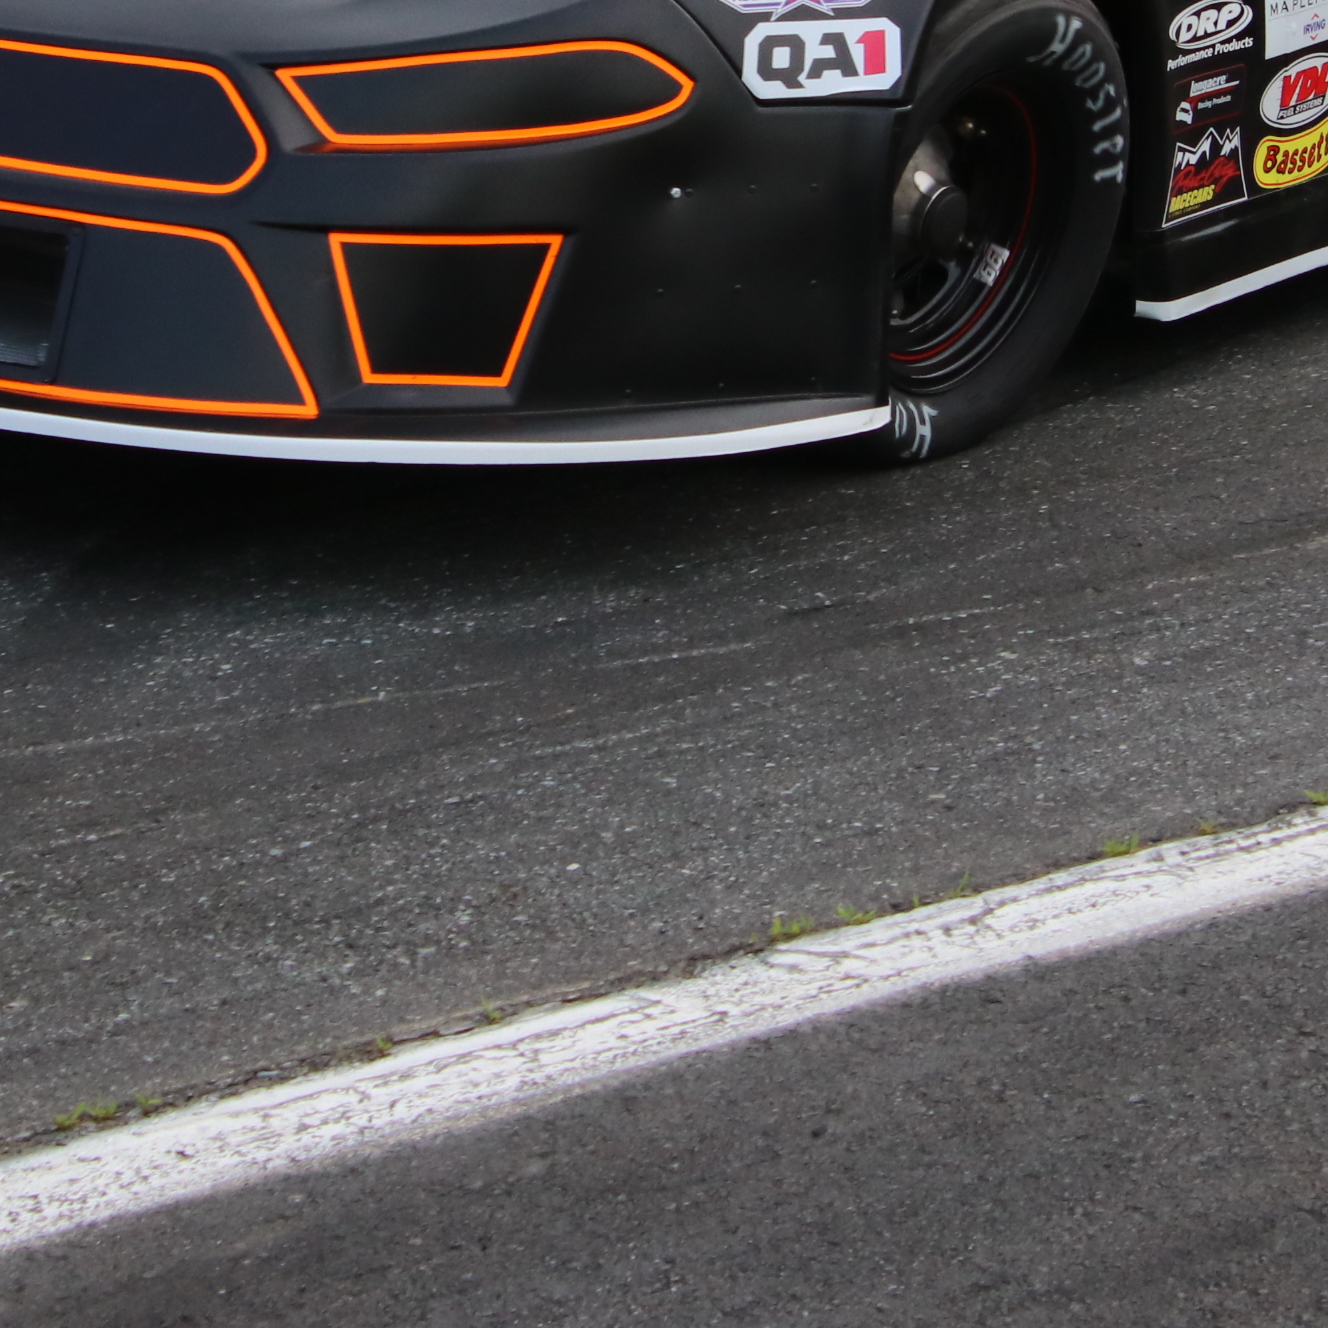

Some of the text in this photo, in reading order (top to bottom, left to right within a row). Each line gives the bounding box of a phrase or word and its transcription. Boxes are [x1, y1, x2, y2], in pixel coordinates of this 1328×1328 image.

[1178, 3, 1242, 44] DRP
[1303, 19, 1326, 36] IRVING
[757, 29, 887, 90] QA1
[1167, 36, 1254, 71] Performance Products
[1277, 97, 1324, 120] FUEL SYSTEMS
[1169, 184, 1215, 214] RACECARS
